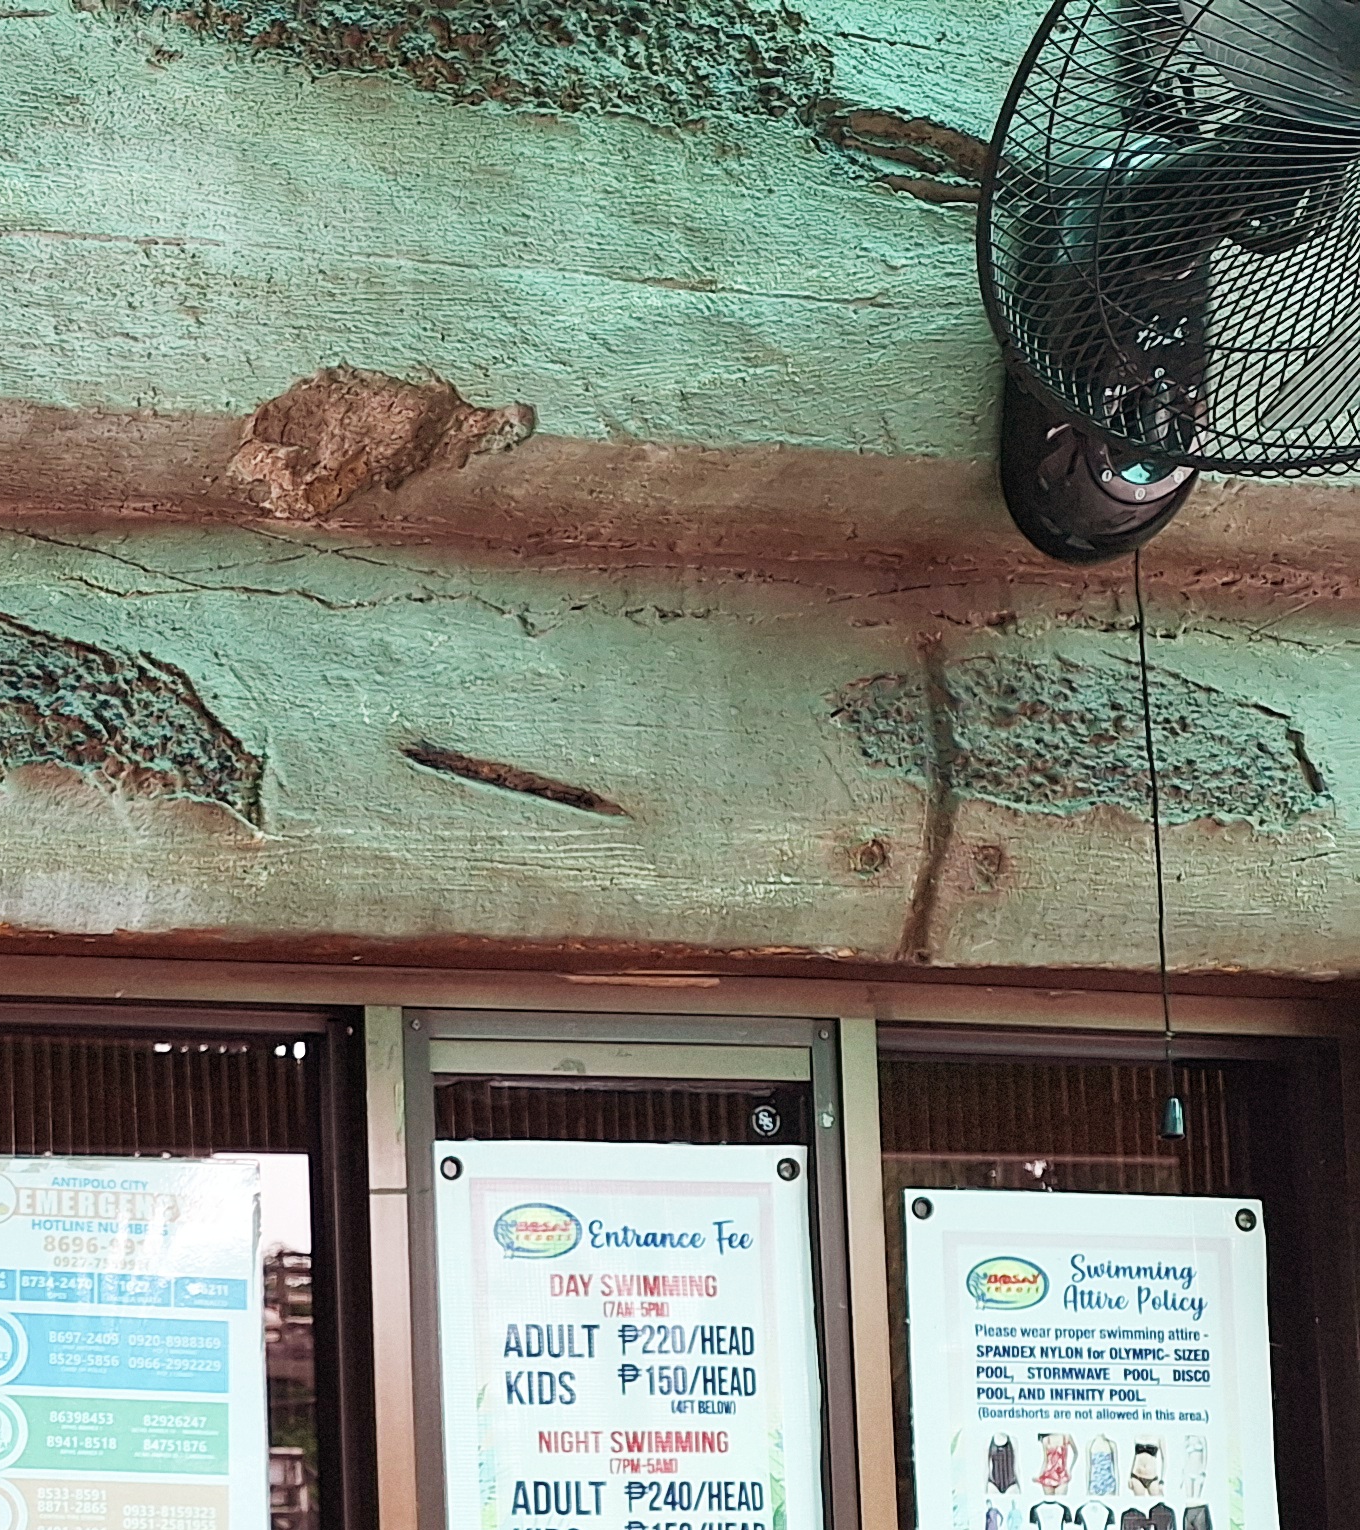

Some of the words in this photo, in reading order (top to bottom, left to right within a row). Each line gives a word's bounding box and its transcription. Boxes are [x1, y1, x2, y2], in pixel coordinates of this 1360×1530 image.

[51, 1176, 116, 1189] ANTIPOLO
[120, 1180, 148, 1191] CITY
[32, 1219, 93, 1233] HOTLINE
[588, 1220, 705, 1250] Entrance
[713, 1220, 753, 1256] Fee
[1071, 1253, 1197, 1284] Swimming
[550, 1274, 592, 1298] DAY
[600, 1274, 718, 1298] SWIMMING
[603, 1302, 669, 1318] (7AM-5PM)
[1063, 1284, 1129, 1314] Attire
[1136, 1287, 1207, 1320] Policy
[504, 1324, 600, 1358] ADULT
[506, 1371, 576, 1405] KIDS
[671, 1401, 694, 1414] (4FT
[697, 1401, 736, 1415] BELOW)
[538, 1431, 603, 1454] NIGHT
[610, 1431, 729, 1454] SWIMMING
[610, 1459, 678, 1474] (7PM-5AM)
[512, 1481, 606, 1515] ADULT
